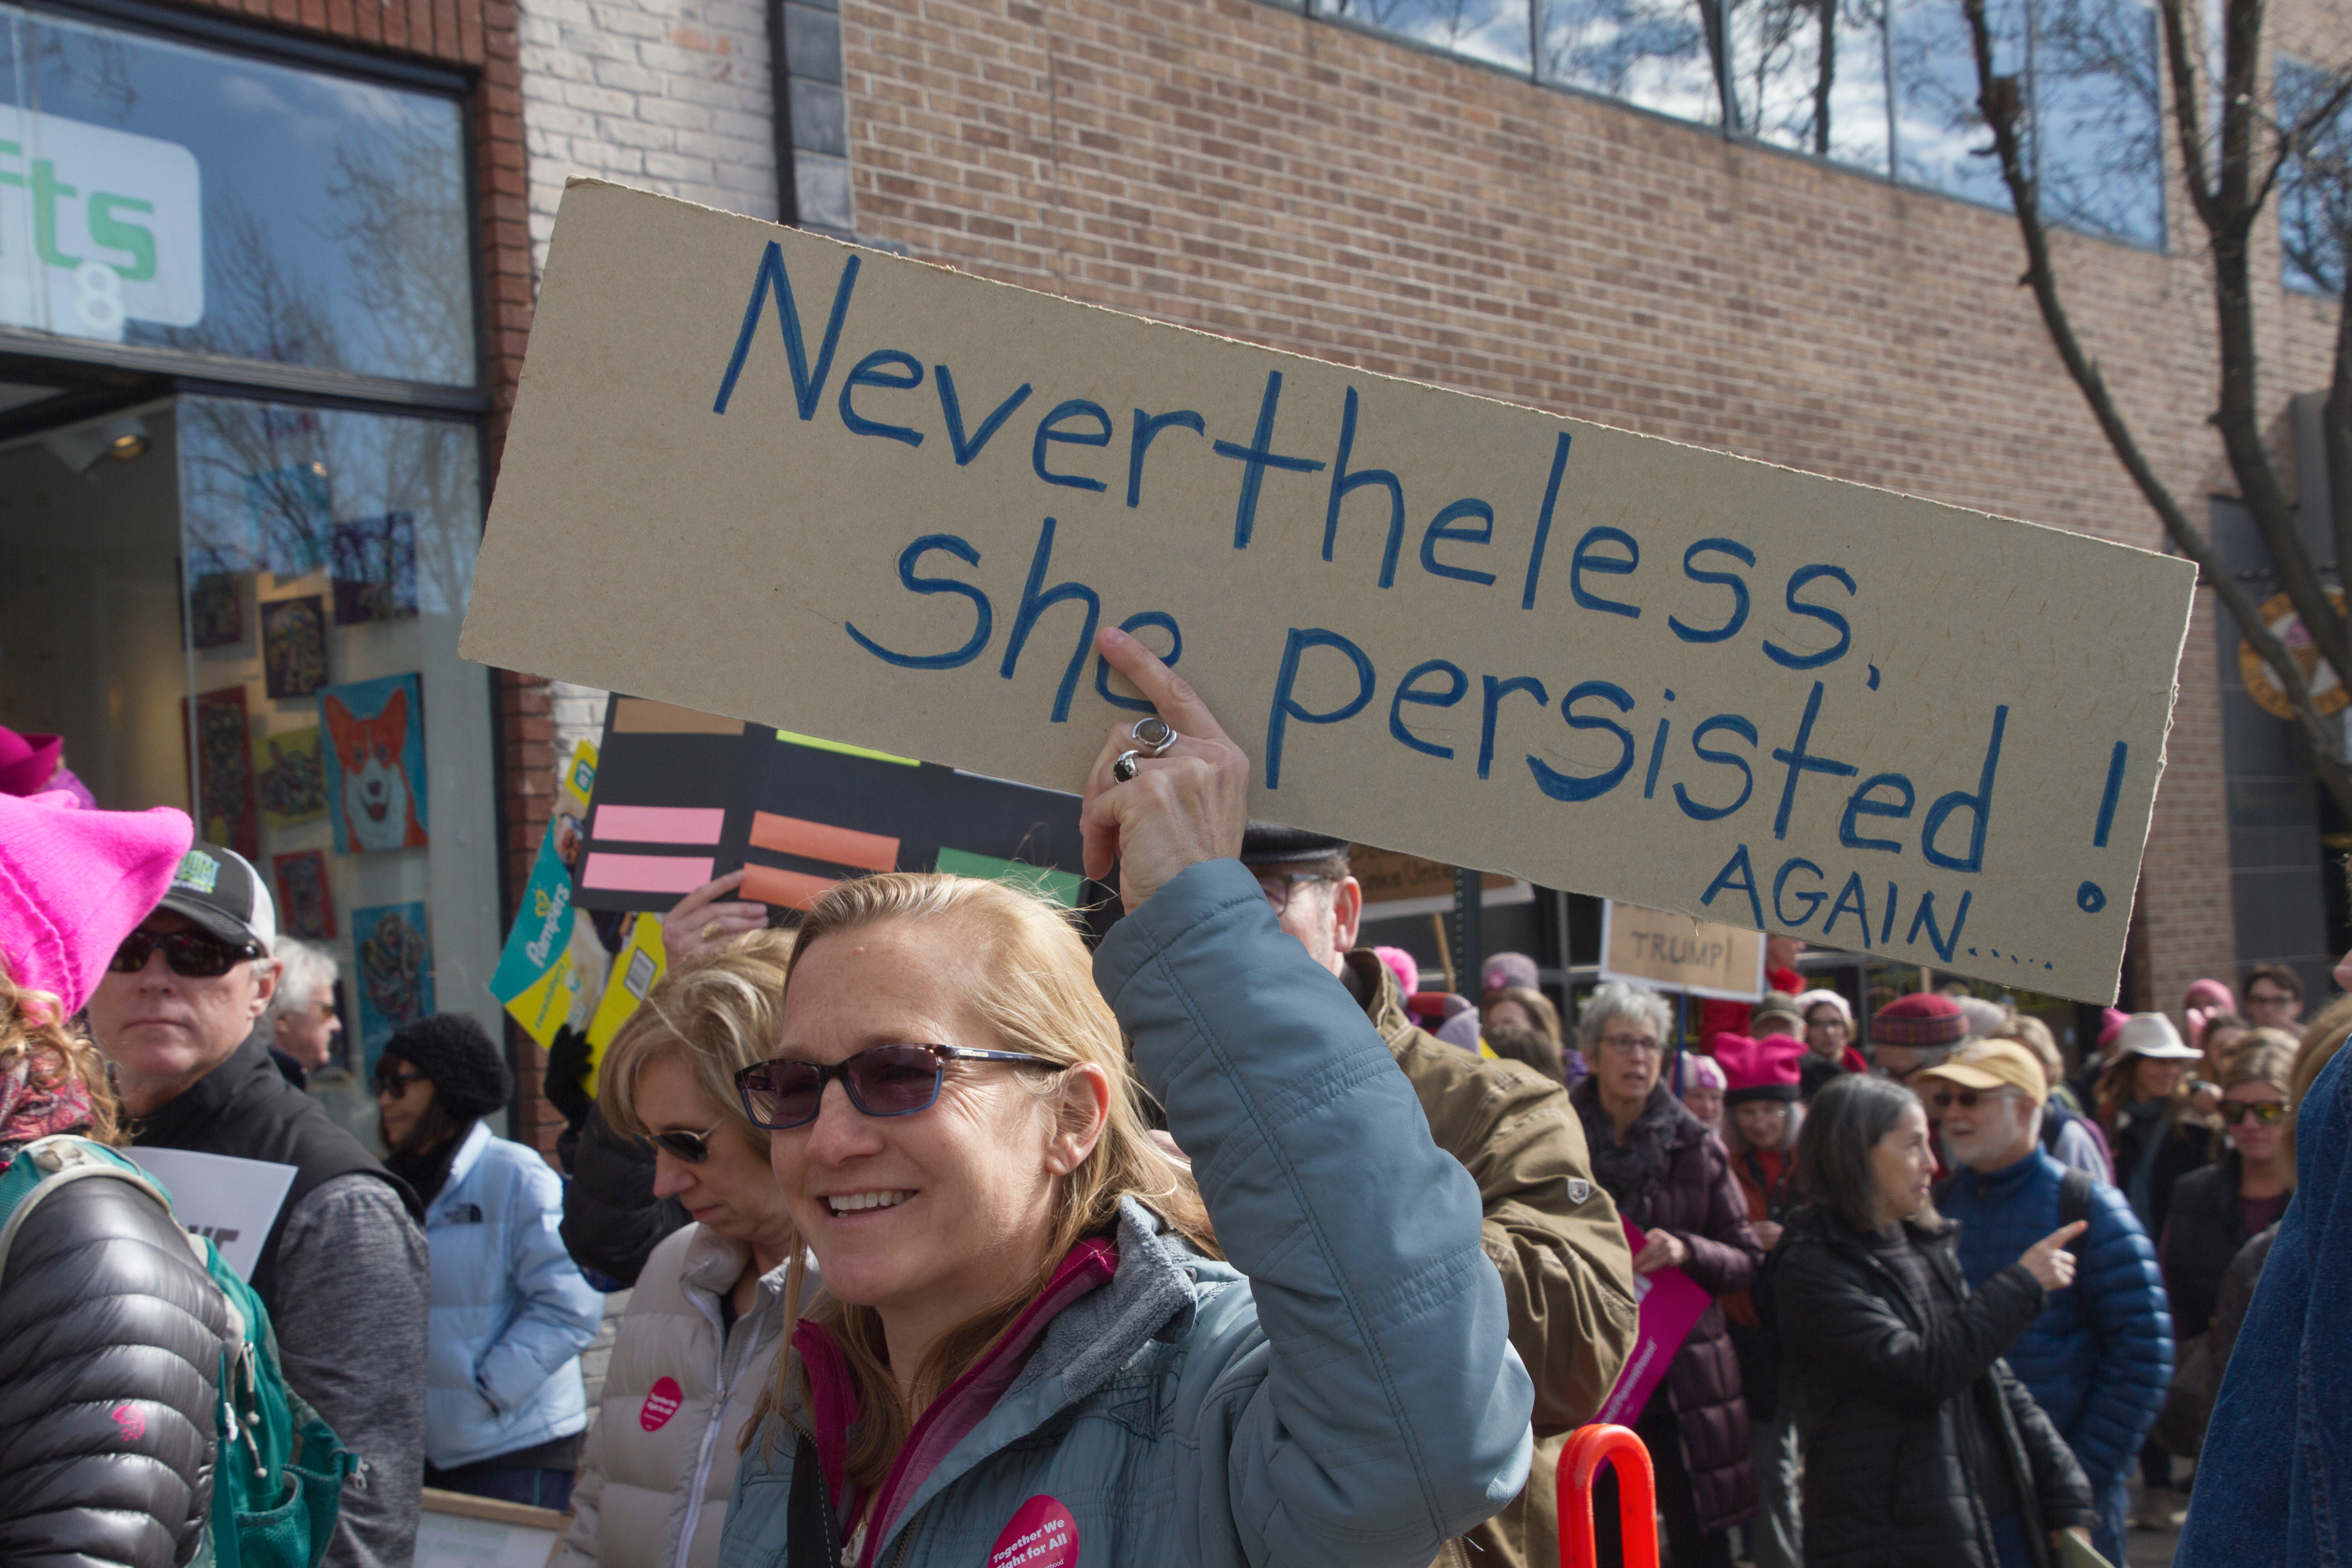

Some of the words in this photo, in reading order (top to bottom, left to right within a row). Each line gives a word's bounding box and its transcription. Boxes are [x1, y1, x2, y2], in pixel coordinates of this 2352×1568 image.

[714, 241, 1879, 690] Nevertheless,
[1266, 628, 2009, 872] persisted
[993, 1529, 1042, 1563] Together
[1043, 1519, 1065, 1534] We
[1027, 1544, 1046, 1559] for
[1049, 1533, 1068, 1550] All
